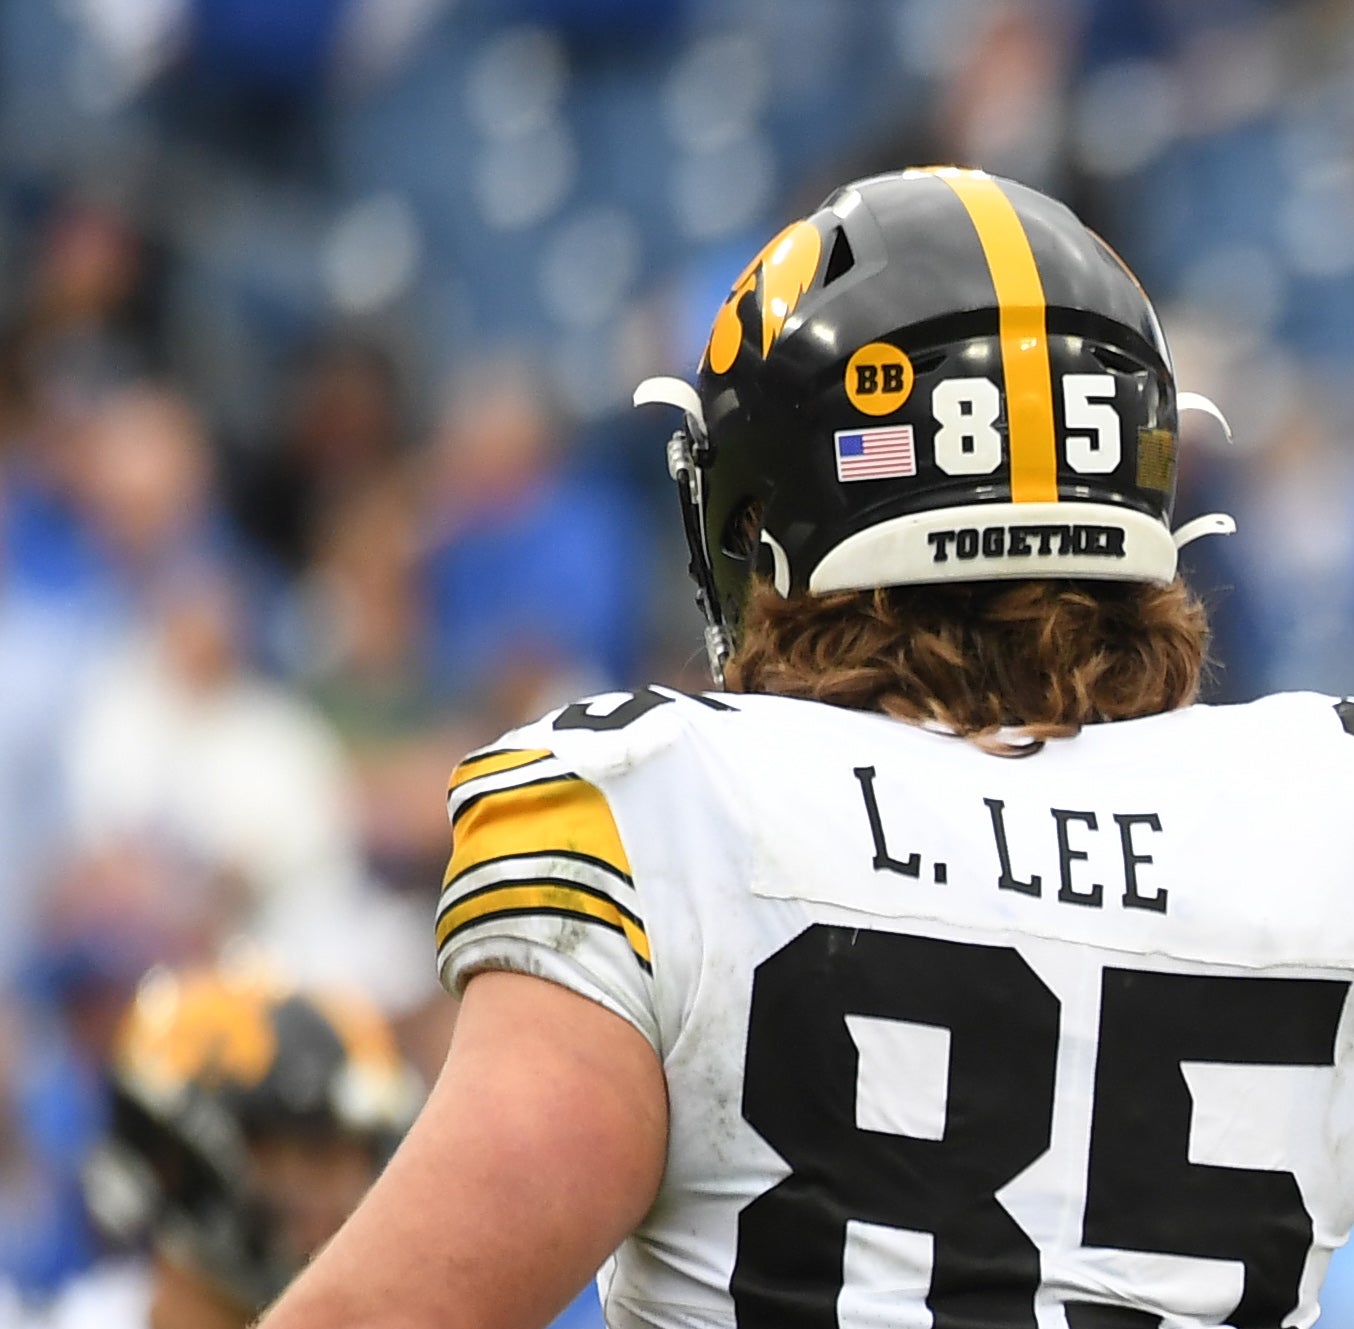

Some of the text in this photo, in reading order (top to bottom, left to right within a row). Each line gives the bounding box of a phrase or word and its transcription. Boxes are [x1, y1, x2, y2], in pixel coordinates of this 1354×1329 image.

[855, 363, 904, 395] BB
[931, 376, 1002, 476] 8
[1061, 373, 1122, 475] 5
[927, 523, 1127, 563] TOGETHER
[853, 765, 1169, 915] L. LEE
